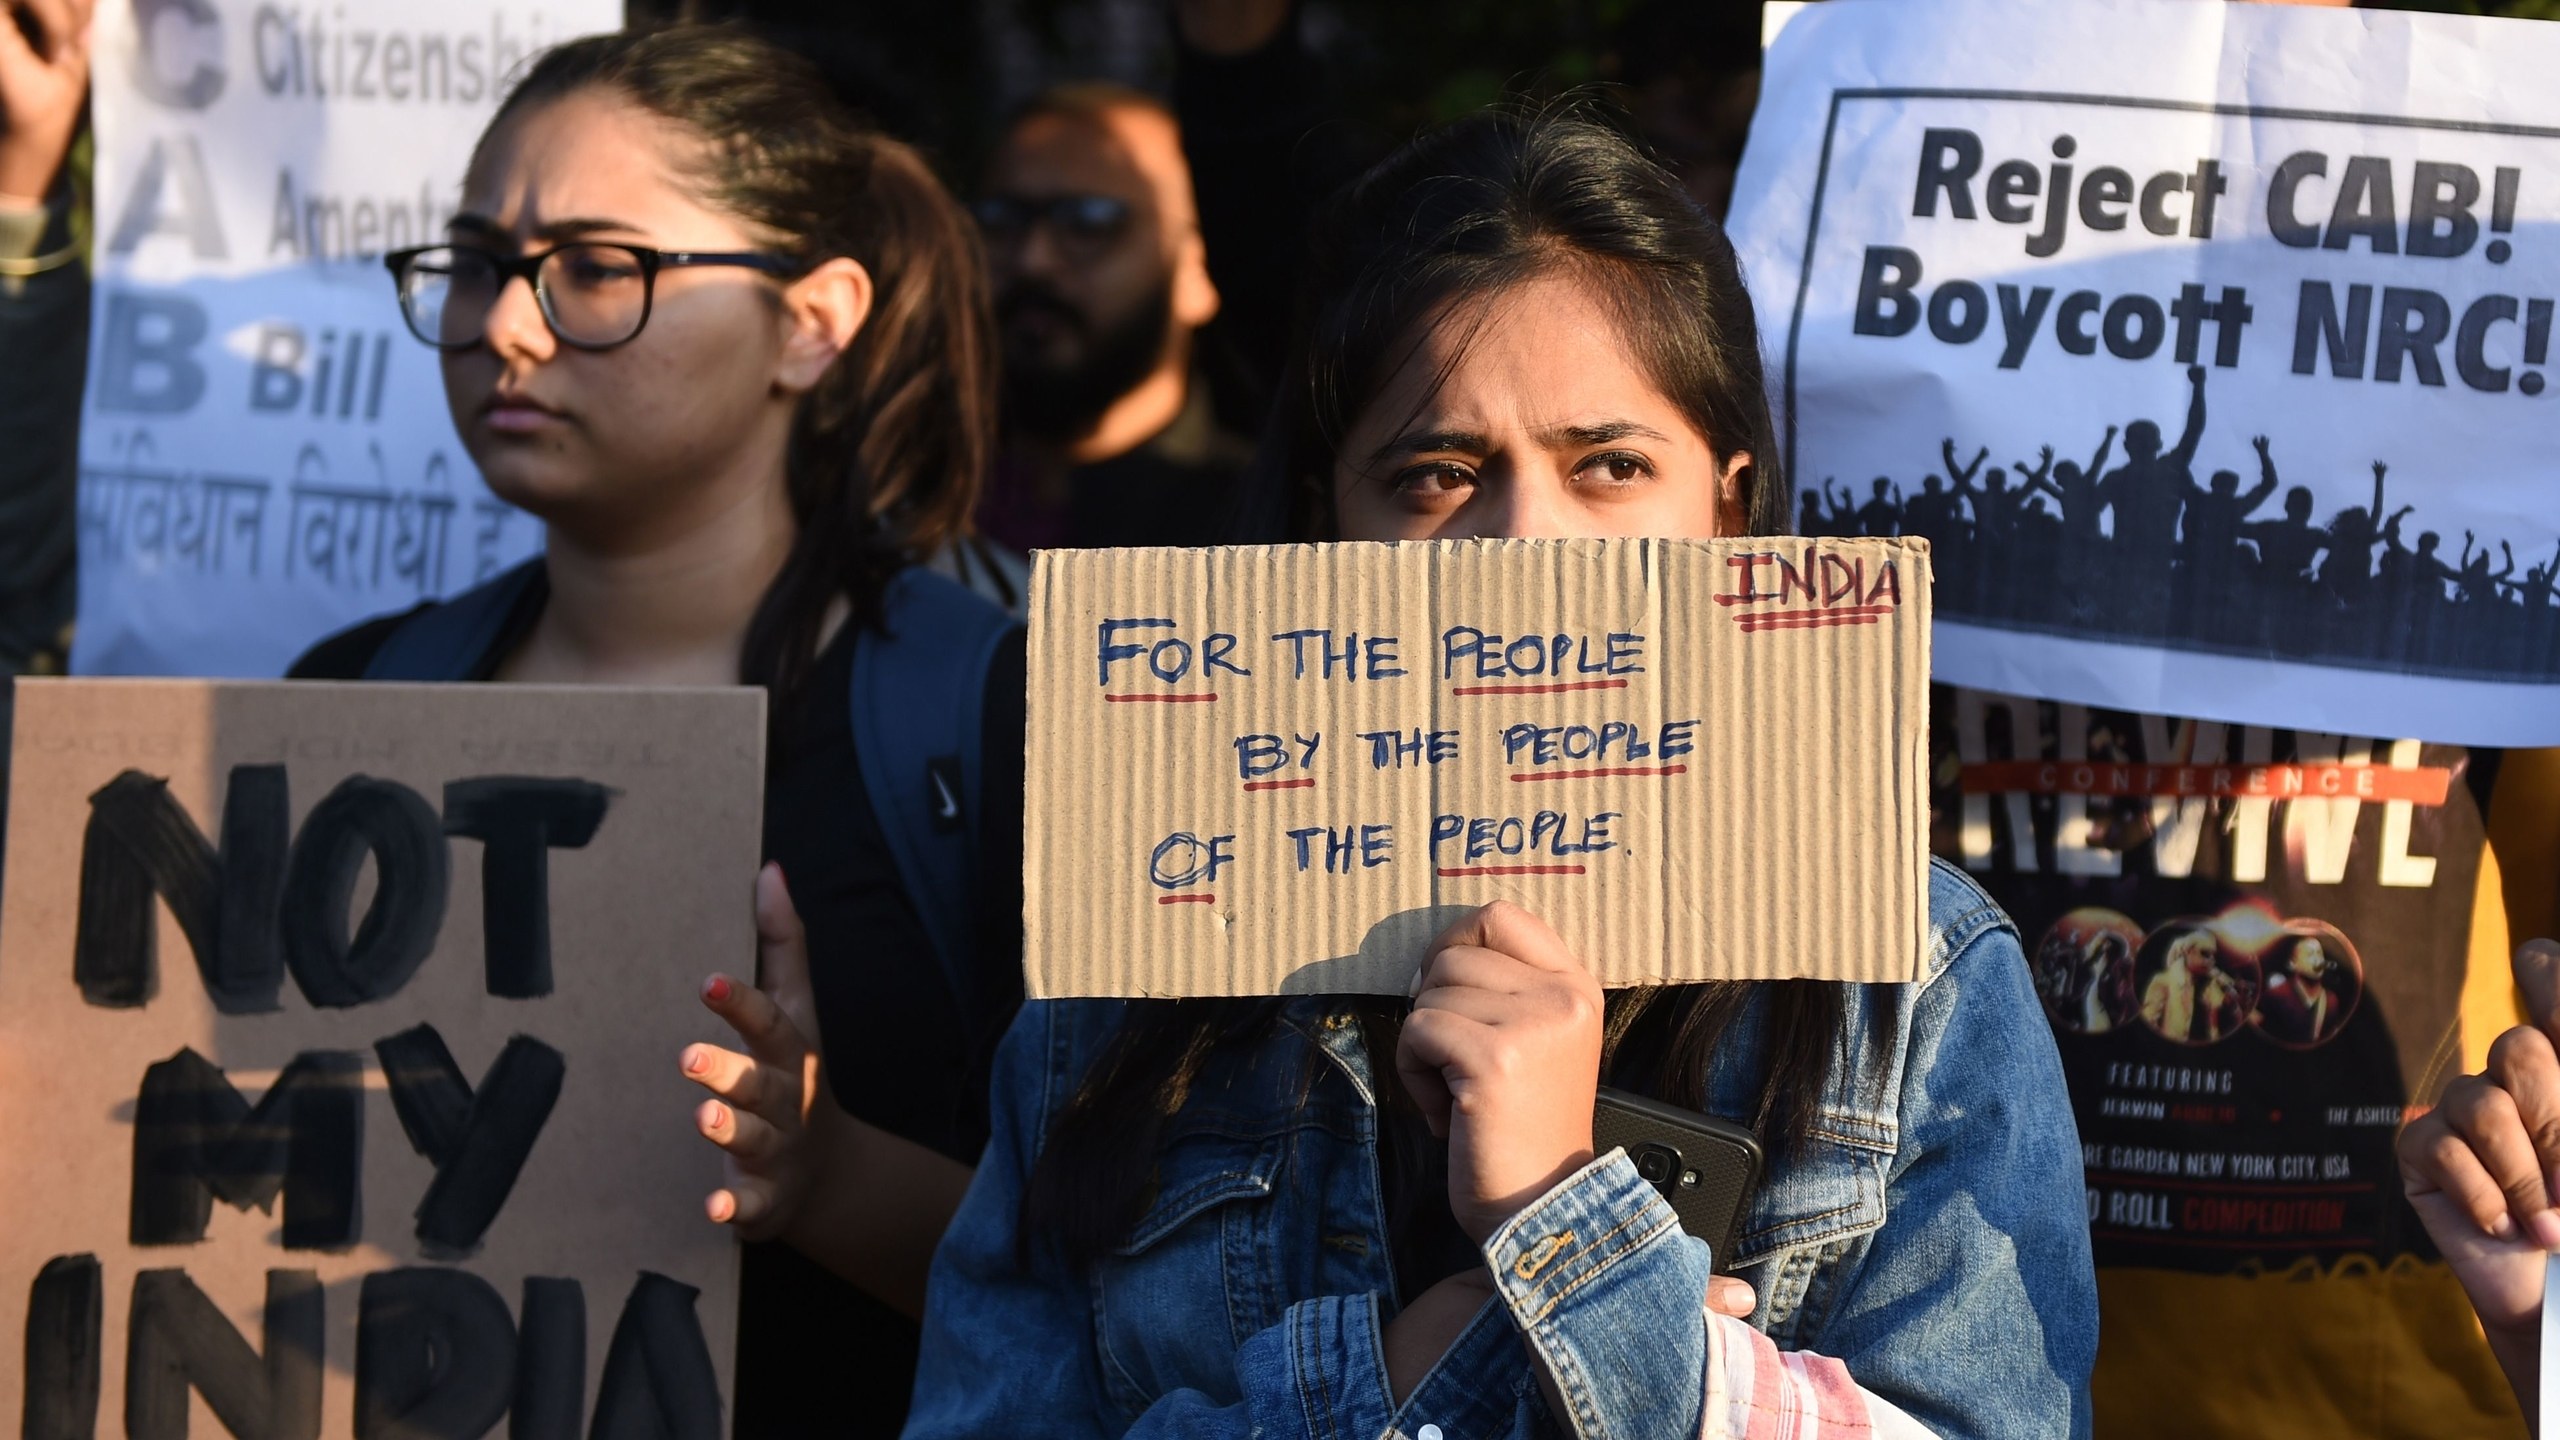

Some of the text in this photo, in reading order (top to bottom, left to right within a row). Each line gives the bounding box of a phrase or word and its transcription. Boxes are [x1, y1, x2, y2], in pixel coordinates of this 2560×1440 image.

[132, 0, 542, 114] C Citizensh
[106, 130, 230, 260] A
[1912, 126, 2522, 265] Reject CAB!
[95, 294, 393, 425] B Bill
[1852, 244, 2556, 397] Boycott NRC!
[1713, 545, 1902, 608] INDIA
[1098, 618, 1646, 686] FOR THE PEOPLE
[1234, 719, 1701, 779] BY THE PEOPLE
[2038, 765, 2376, 796] CONFERENCE
[73, 761, 626, 1015] NOT
[1150, 831, 1236, 890] OF
[1287, 824, 1393, 874] THE
[2107, 1060, 2234, 1094] FEATURING
[129, 1020, 567, 1262] MY
[2109, 1145, 2180, 1174] GARDEN
[2185, 1151, 2226, 1178] NEW
[2230, 1154, 2276, 1180] YORK
[2323, 1154, 2351, 1180] USA
[2110, 1190, 2174, 1230] ROLL
[21, 1251, 726, 1440] INDIA
